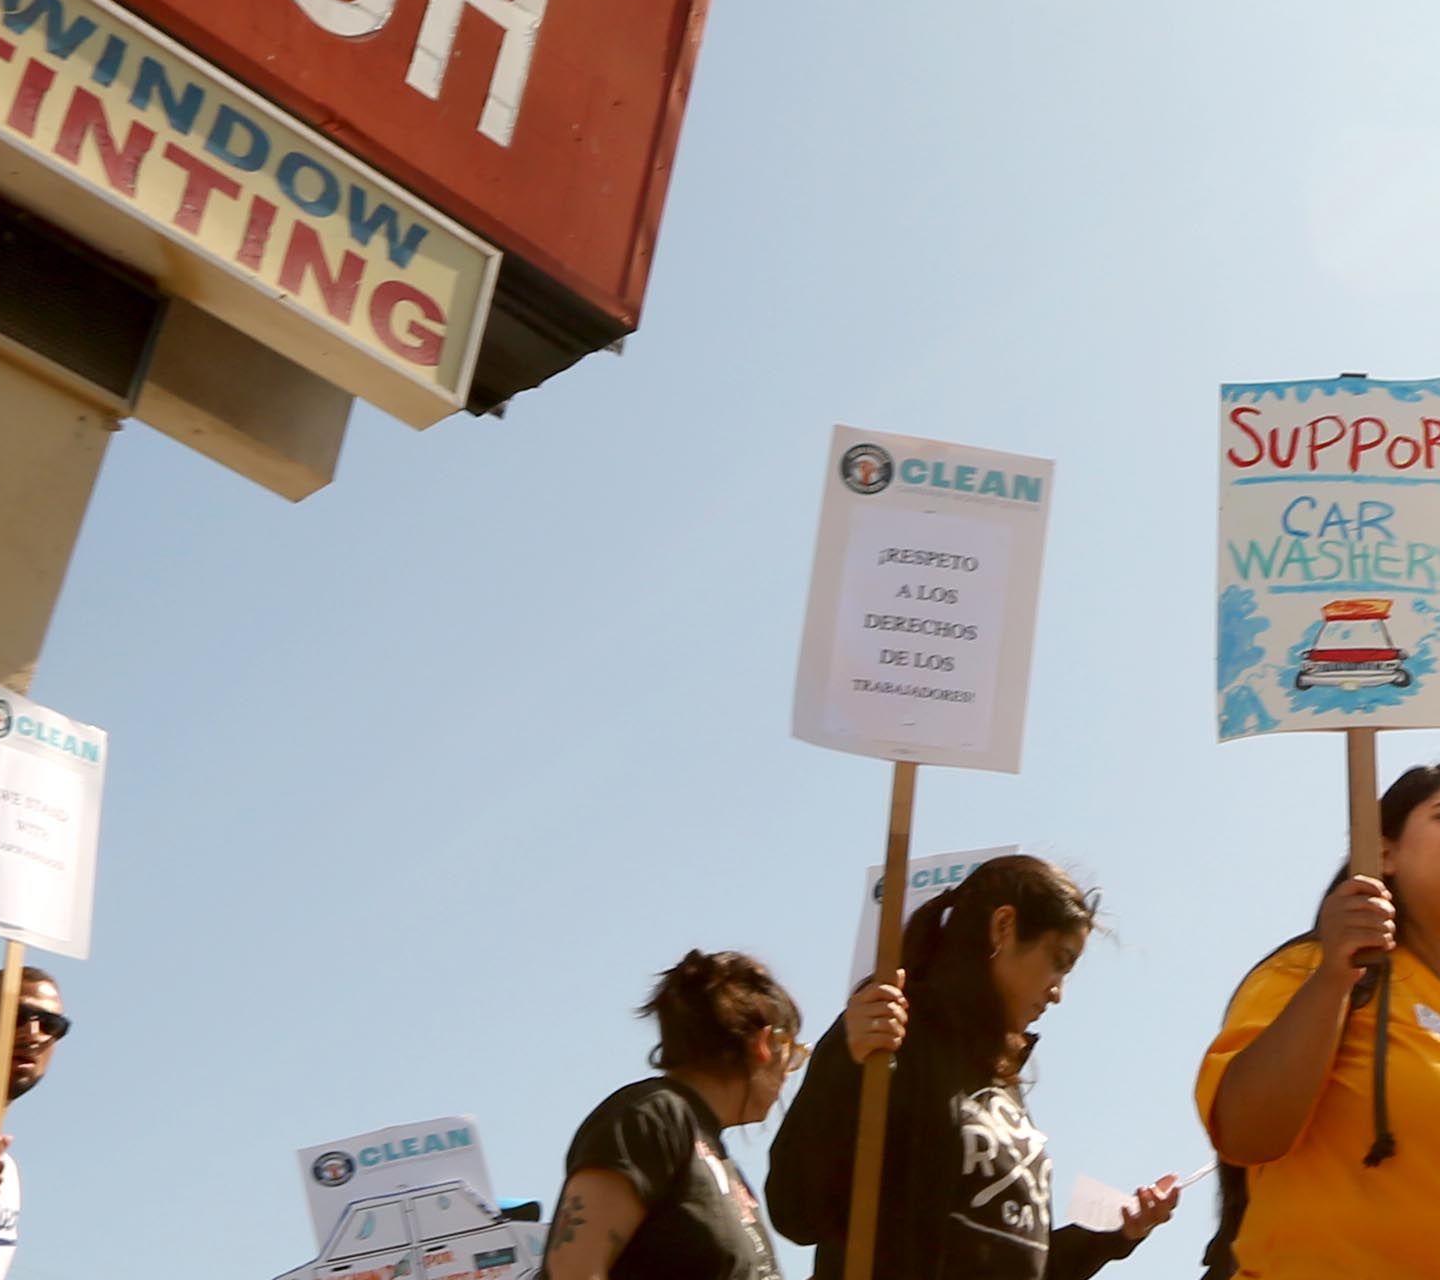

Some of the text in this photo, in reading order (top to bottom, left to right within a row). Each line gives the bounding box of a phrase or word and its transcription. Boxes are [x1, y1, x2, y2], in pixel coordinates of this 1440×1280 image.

[899, 458, 1044, 504] CLEAN
[1281, 495, 1398, 541] CAR
[878, 547, 980, 573] ¡RESPETO
[895, 583, 960, 605] A LOS
[863, 612, 979, 642] DERECHOS
[879, 648, 956, 673] DE LOS
[16, 714, 101, 763] CLEAN
[358, 1127, 474, 1168] CLEAN
